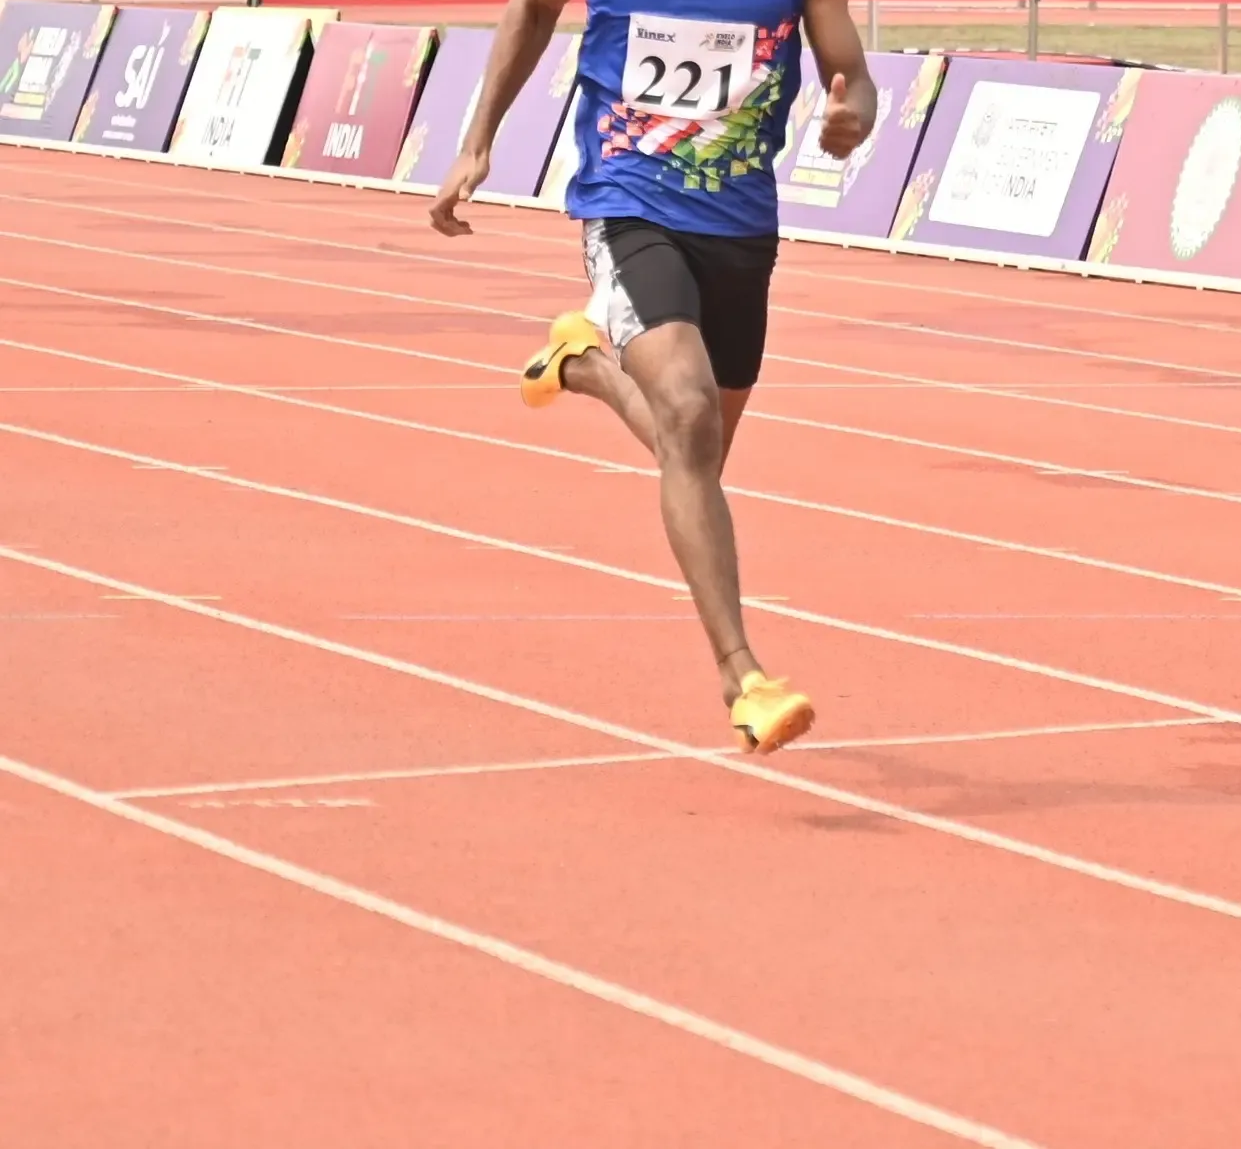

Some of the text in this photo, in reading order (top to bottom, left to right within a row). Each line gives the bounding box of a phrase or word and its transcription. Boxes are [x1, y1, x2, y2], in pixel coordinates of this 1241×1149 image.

[636, 27, 676, 43] Vinex
[115, 44, 165, 109] SAI
[634, 56, 733, 112] 221
[322, 122, 364, 159] INDIA
